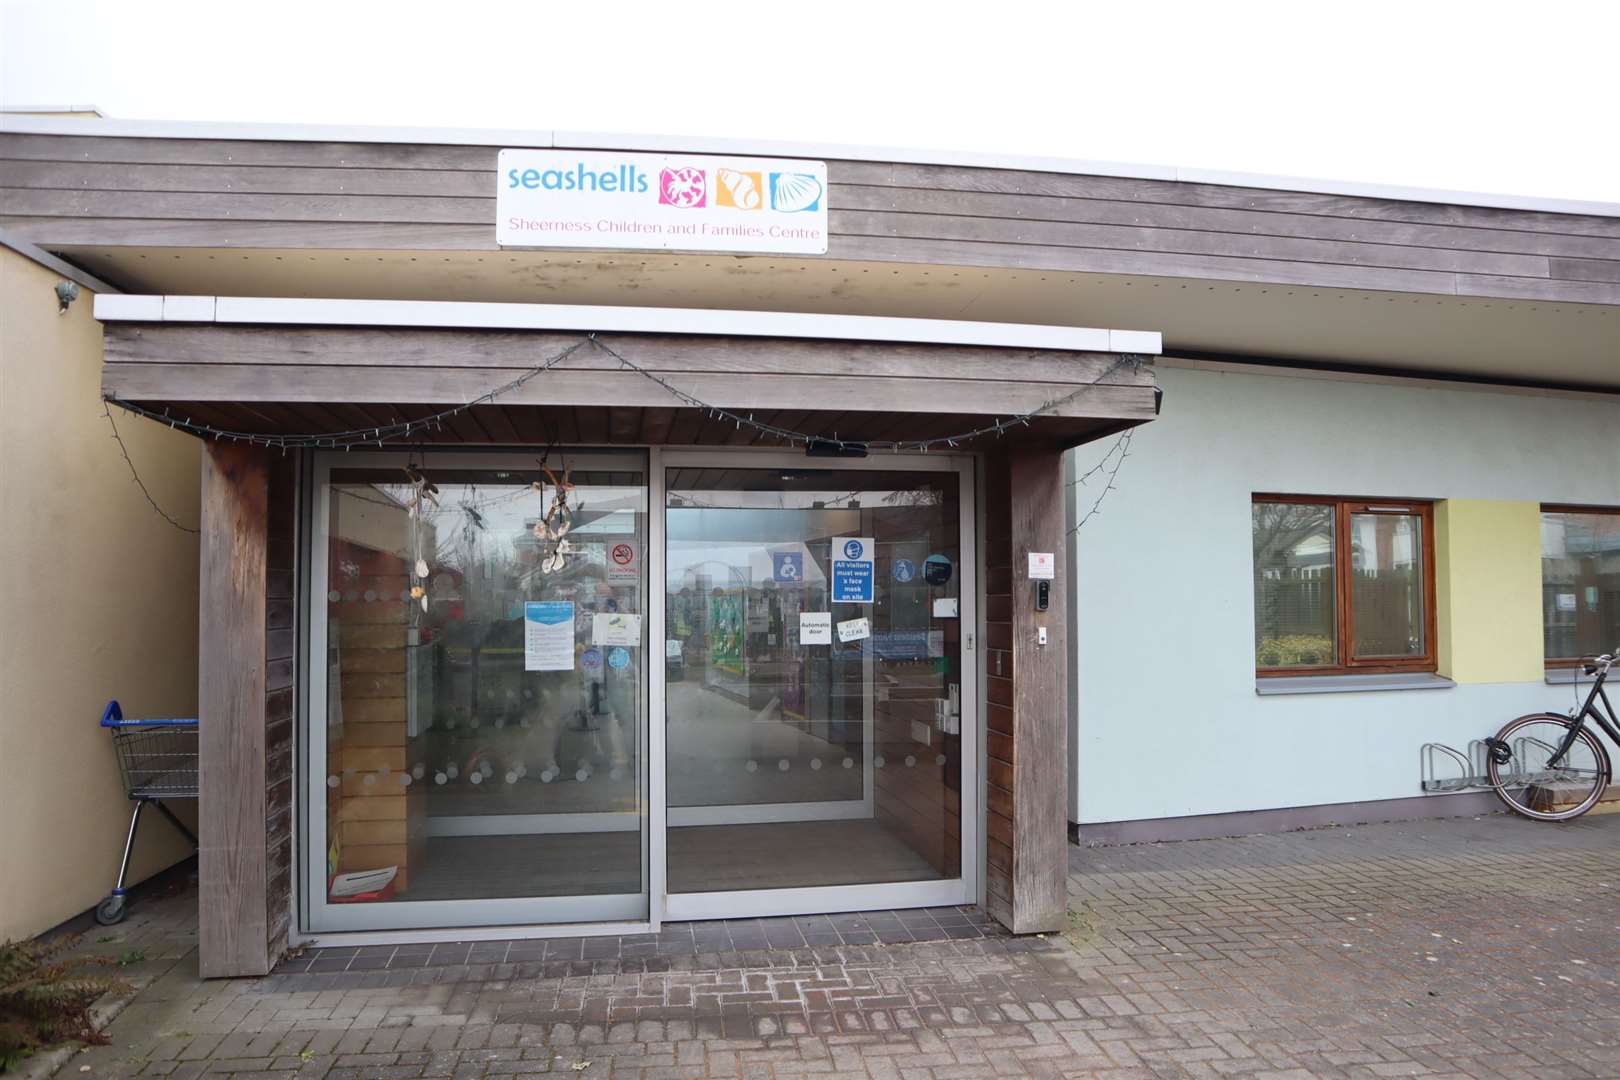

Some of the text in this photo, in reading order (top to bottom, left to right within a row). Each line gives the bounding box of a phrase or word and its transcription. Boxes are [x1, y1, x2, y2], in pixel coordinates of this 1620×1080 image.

[508, 162, 649, 193] seashells
[509, 217, 820, 239] Sheerness Children and Families Centre
